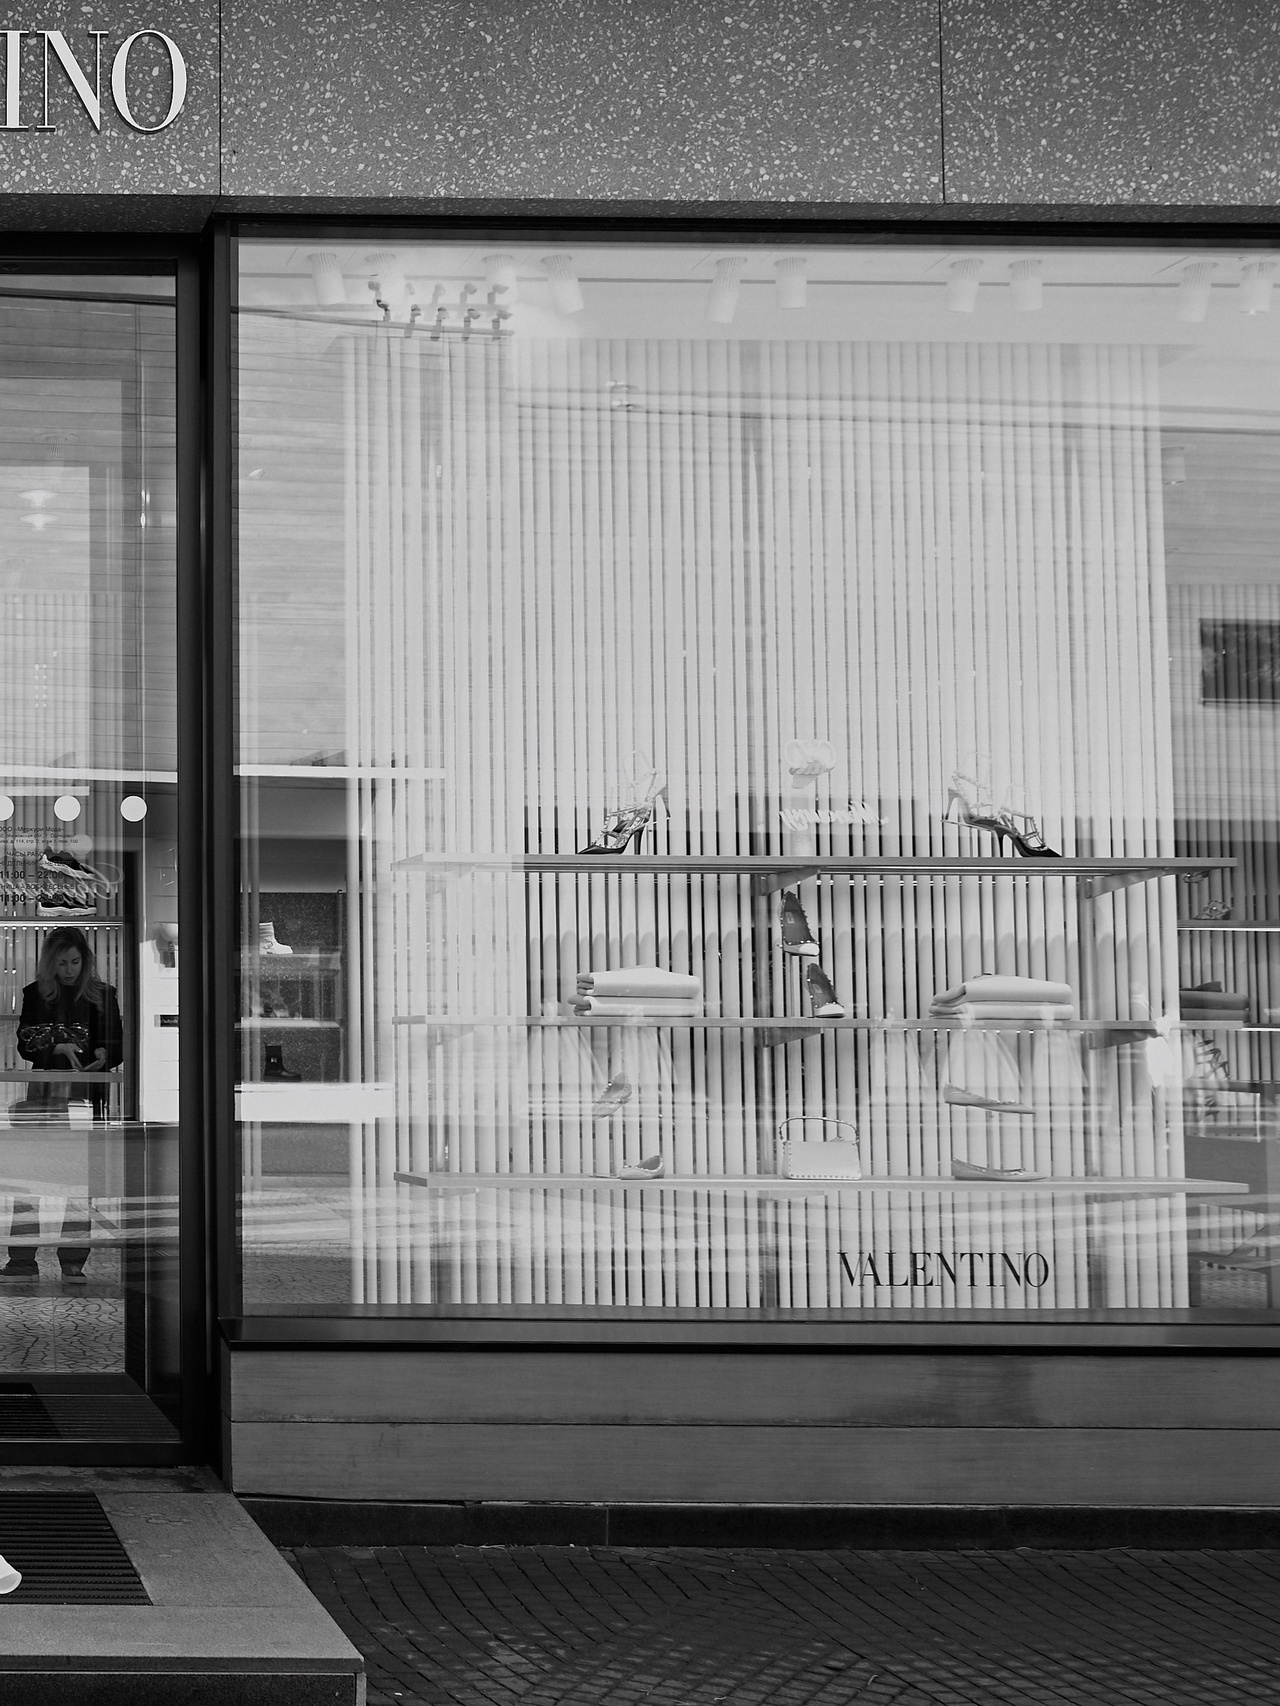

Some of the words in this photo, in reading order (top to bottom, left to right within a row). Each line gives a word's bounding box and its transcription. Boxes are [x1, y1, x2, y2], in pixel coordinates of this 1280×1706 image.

[0, 870, 26, 879] 11:00
[37, 870, 64, 879] 22:00
[0, 893, 26, 902] 11:00
[836, 1251, 1049, 1288] VALENTINO
